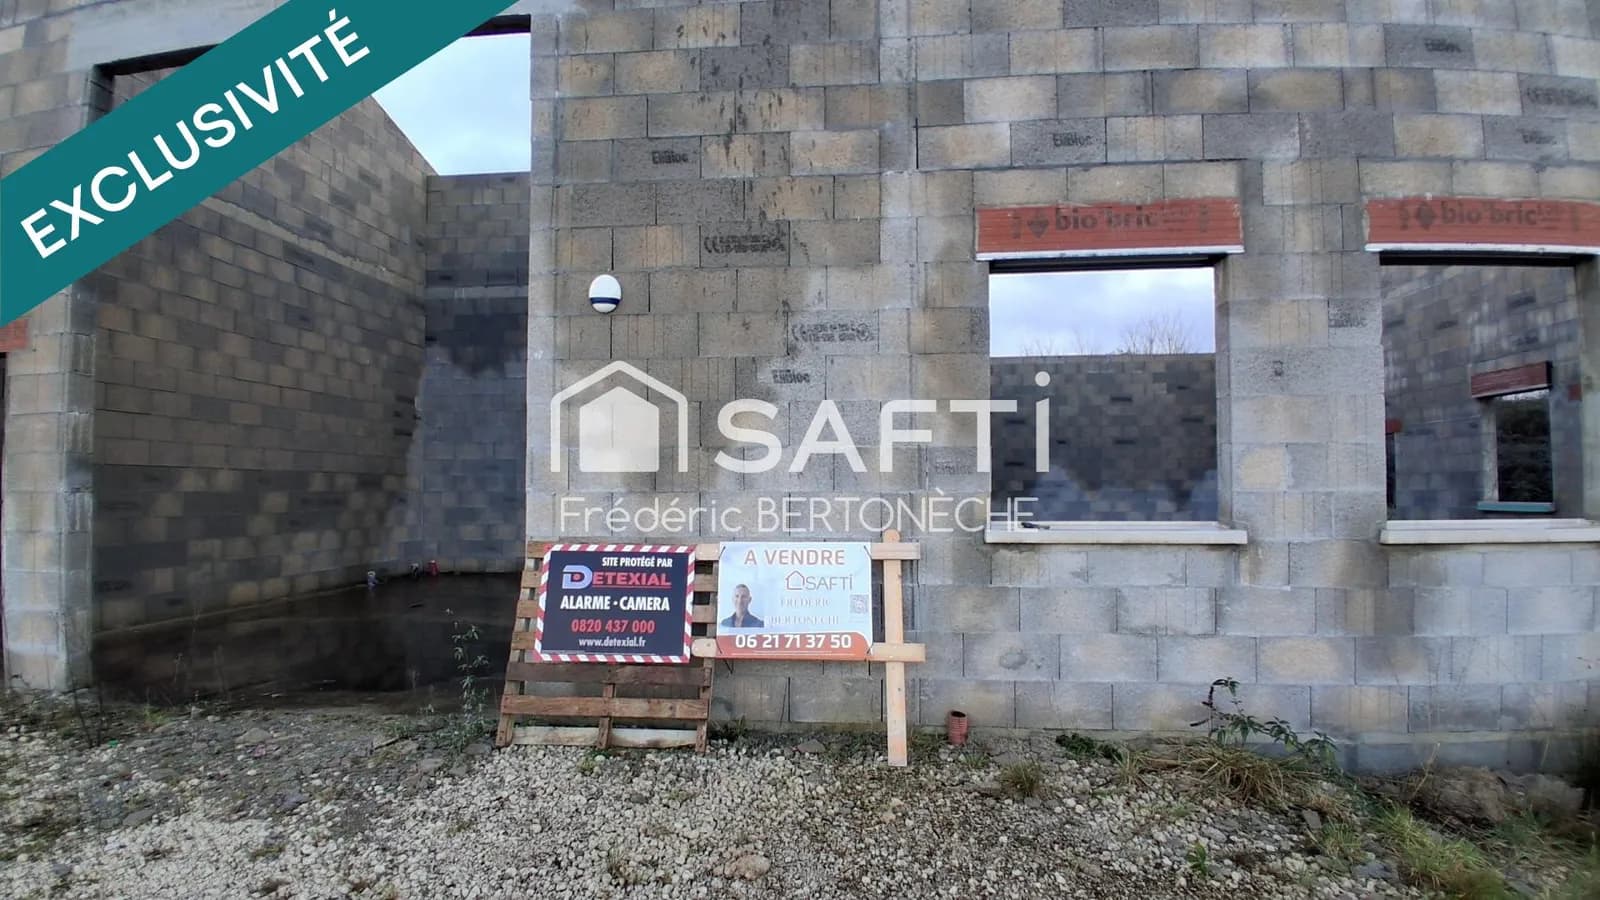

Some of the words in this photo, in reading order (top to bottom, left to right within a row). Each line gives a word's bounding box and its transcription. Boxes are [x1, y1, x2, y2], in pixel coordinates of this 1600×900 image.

[602, 557, 618, 567] SITE
[620, 556, 655, 567] PROTÉGÉ
[656, 558, 673, 567] PAR
[744, 550, 757, 566] A
[765, 549, 845, 566] VENDRE
[562, 565, 672, 589] DETEXIAL
[560, 595, 611, 610] ALARME
[620, 597, 671, 611] CAMERA
[571, 619, 601, 633] 0820
[605, 619, 628, 632] 437
[632, 620, 656, 633] 000
[579, 636, 647, 647] www.detexial.fr
[735, 635, 757, 648] 06
[762, 634, 779, 648] 21
[784, 634, 801, 648] 71
[805, 634, 826, 648] 37
[830, 634, 852, 648] 50
